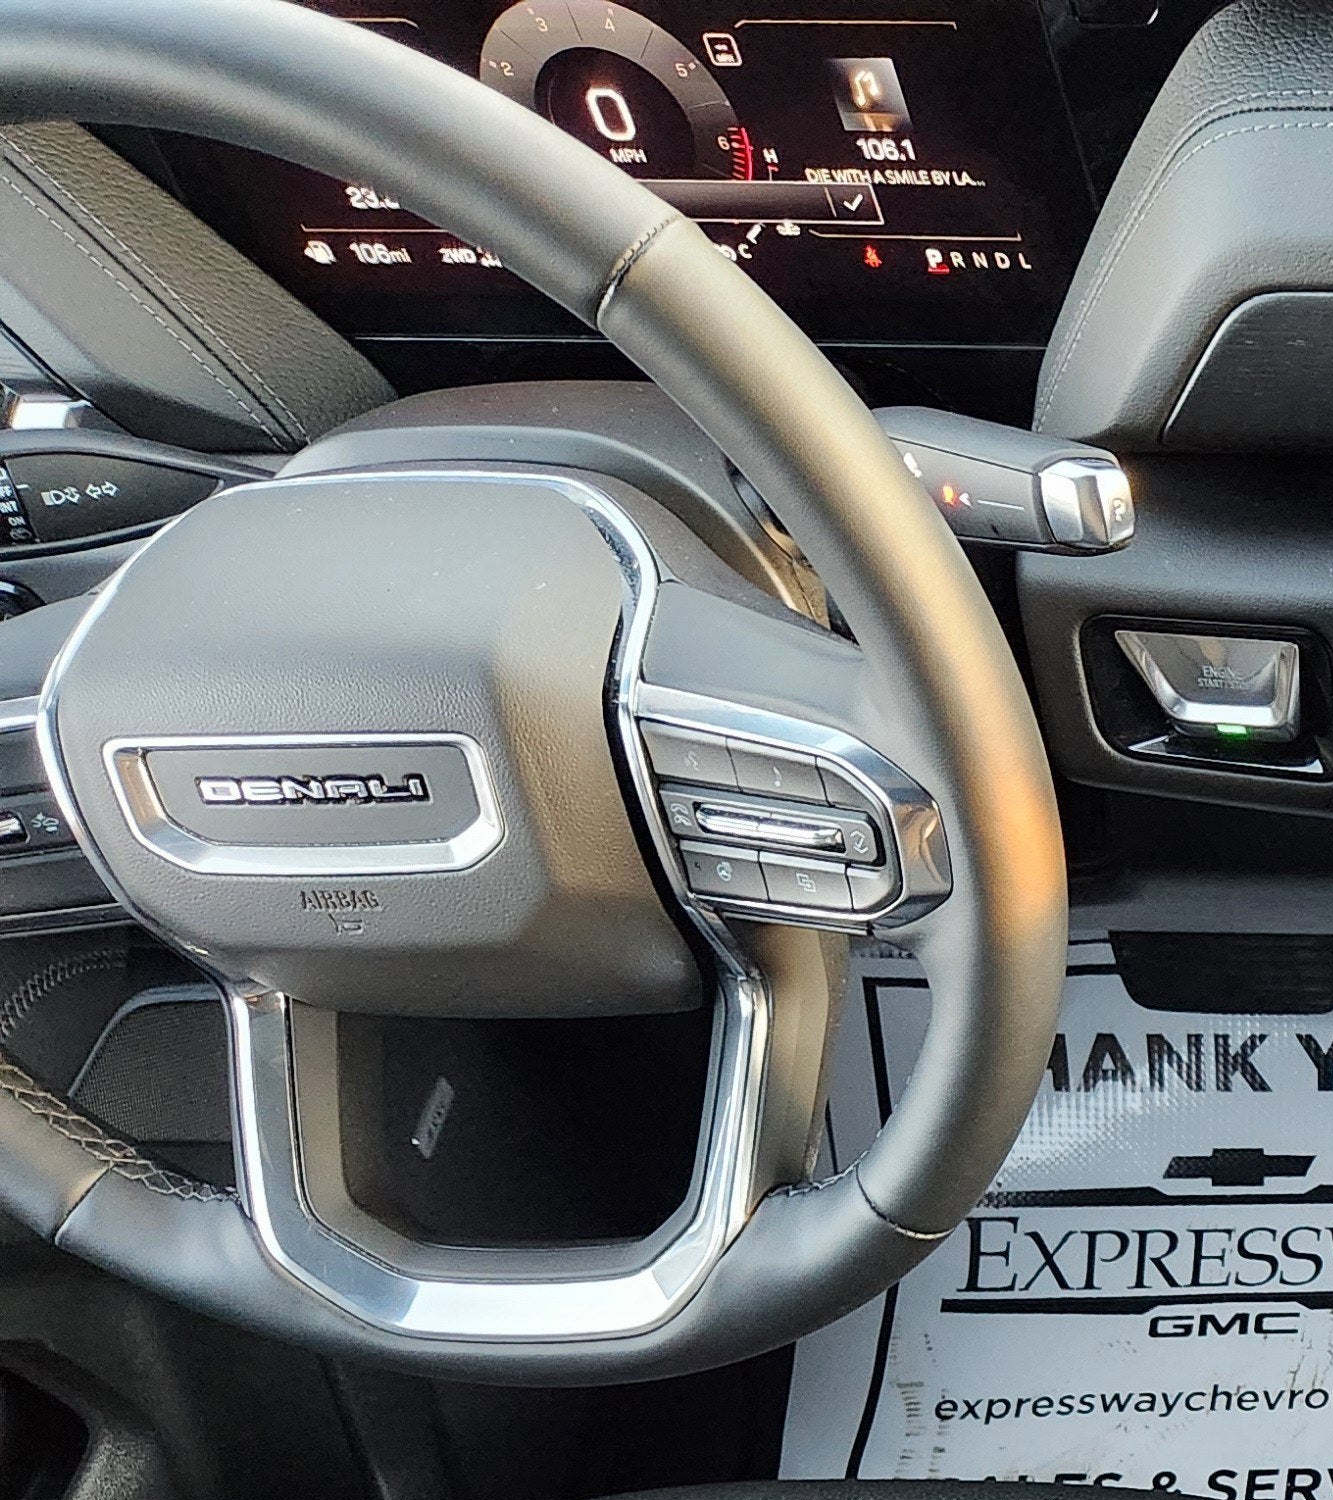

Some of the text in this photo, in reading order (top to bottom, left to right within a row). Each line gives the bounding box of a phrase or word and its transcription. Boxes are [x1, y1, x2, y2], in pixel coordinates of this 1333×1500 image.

[536, 18, 548, 32] 3
[604, 18, 616, 33] 4
[500, 62, 514, 77] 2
[675, 63, 688, 77] 5
[585, 86, 636, 141] 0
[717, 136, 730, 150] 6
[857, 138, 916, 161] 106.1
[610, 148, 648, 163] MPH
[762, 148, 778, 164] H
[805, 168, 831, 184] DIE
[831, 169, 872, 185] WITH
[873, 170, 886, 184] A
[885, 170, 931, 185] SMILE
[437, 248, 477, 264] 2WD
[925, 248, 1033, 270] P R N D L
[197, 775, 430, 804] DENALI
[1148, 1311, 1301, 1338] GMC
